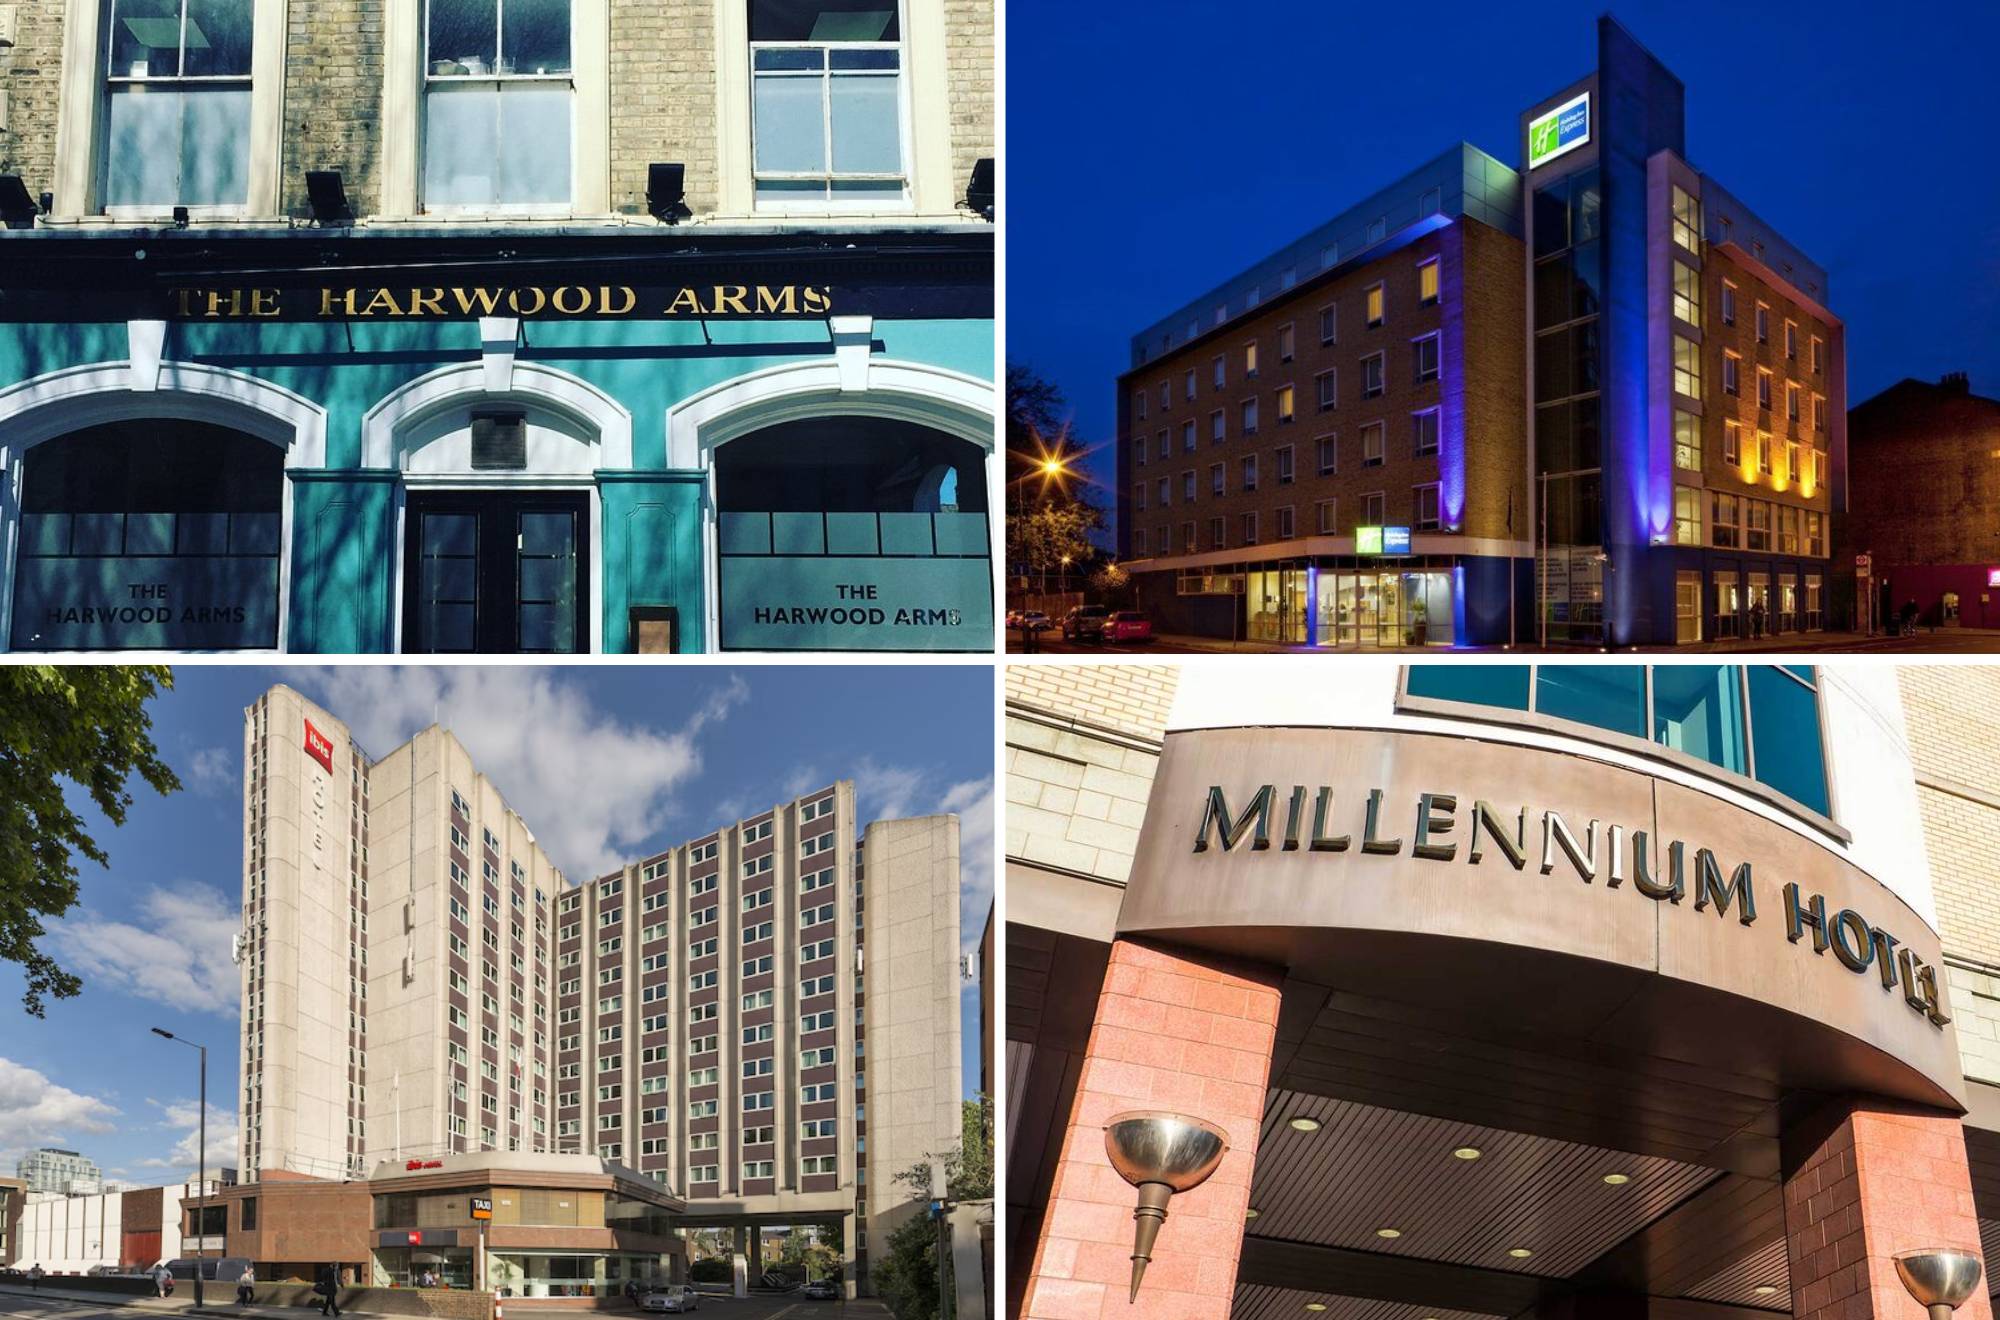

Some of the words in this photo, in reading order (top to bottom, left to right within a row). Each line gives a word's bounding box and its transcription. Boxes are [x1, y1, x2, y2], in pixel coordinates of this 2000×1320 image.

[167, 287, 281, 317] THE
[316, 286, 636, 316] HARWOOD
[663, 285, 832, 315] ARMS
[127, 584, 168, 599] THE
[835, 584, 878, 600] THE
[48, 607, 173, 625] HARWOOD
[181, 607, 246, 624] ARMS
[754, 606, 886, 625] HARWOOD
[893, 607, 962, 626] ARMS
[310, 730, 330, 759] ibis
[1193, 784, 1760, 928] MILLENNIUM
[1782, 881, 1952, 1031] HOTEL
[474, 1199, 491, 1210] TAXI
